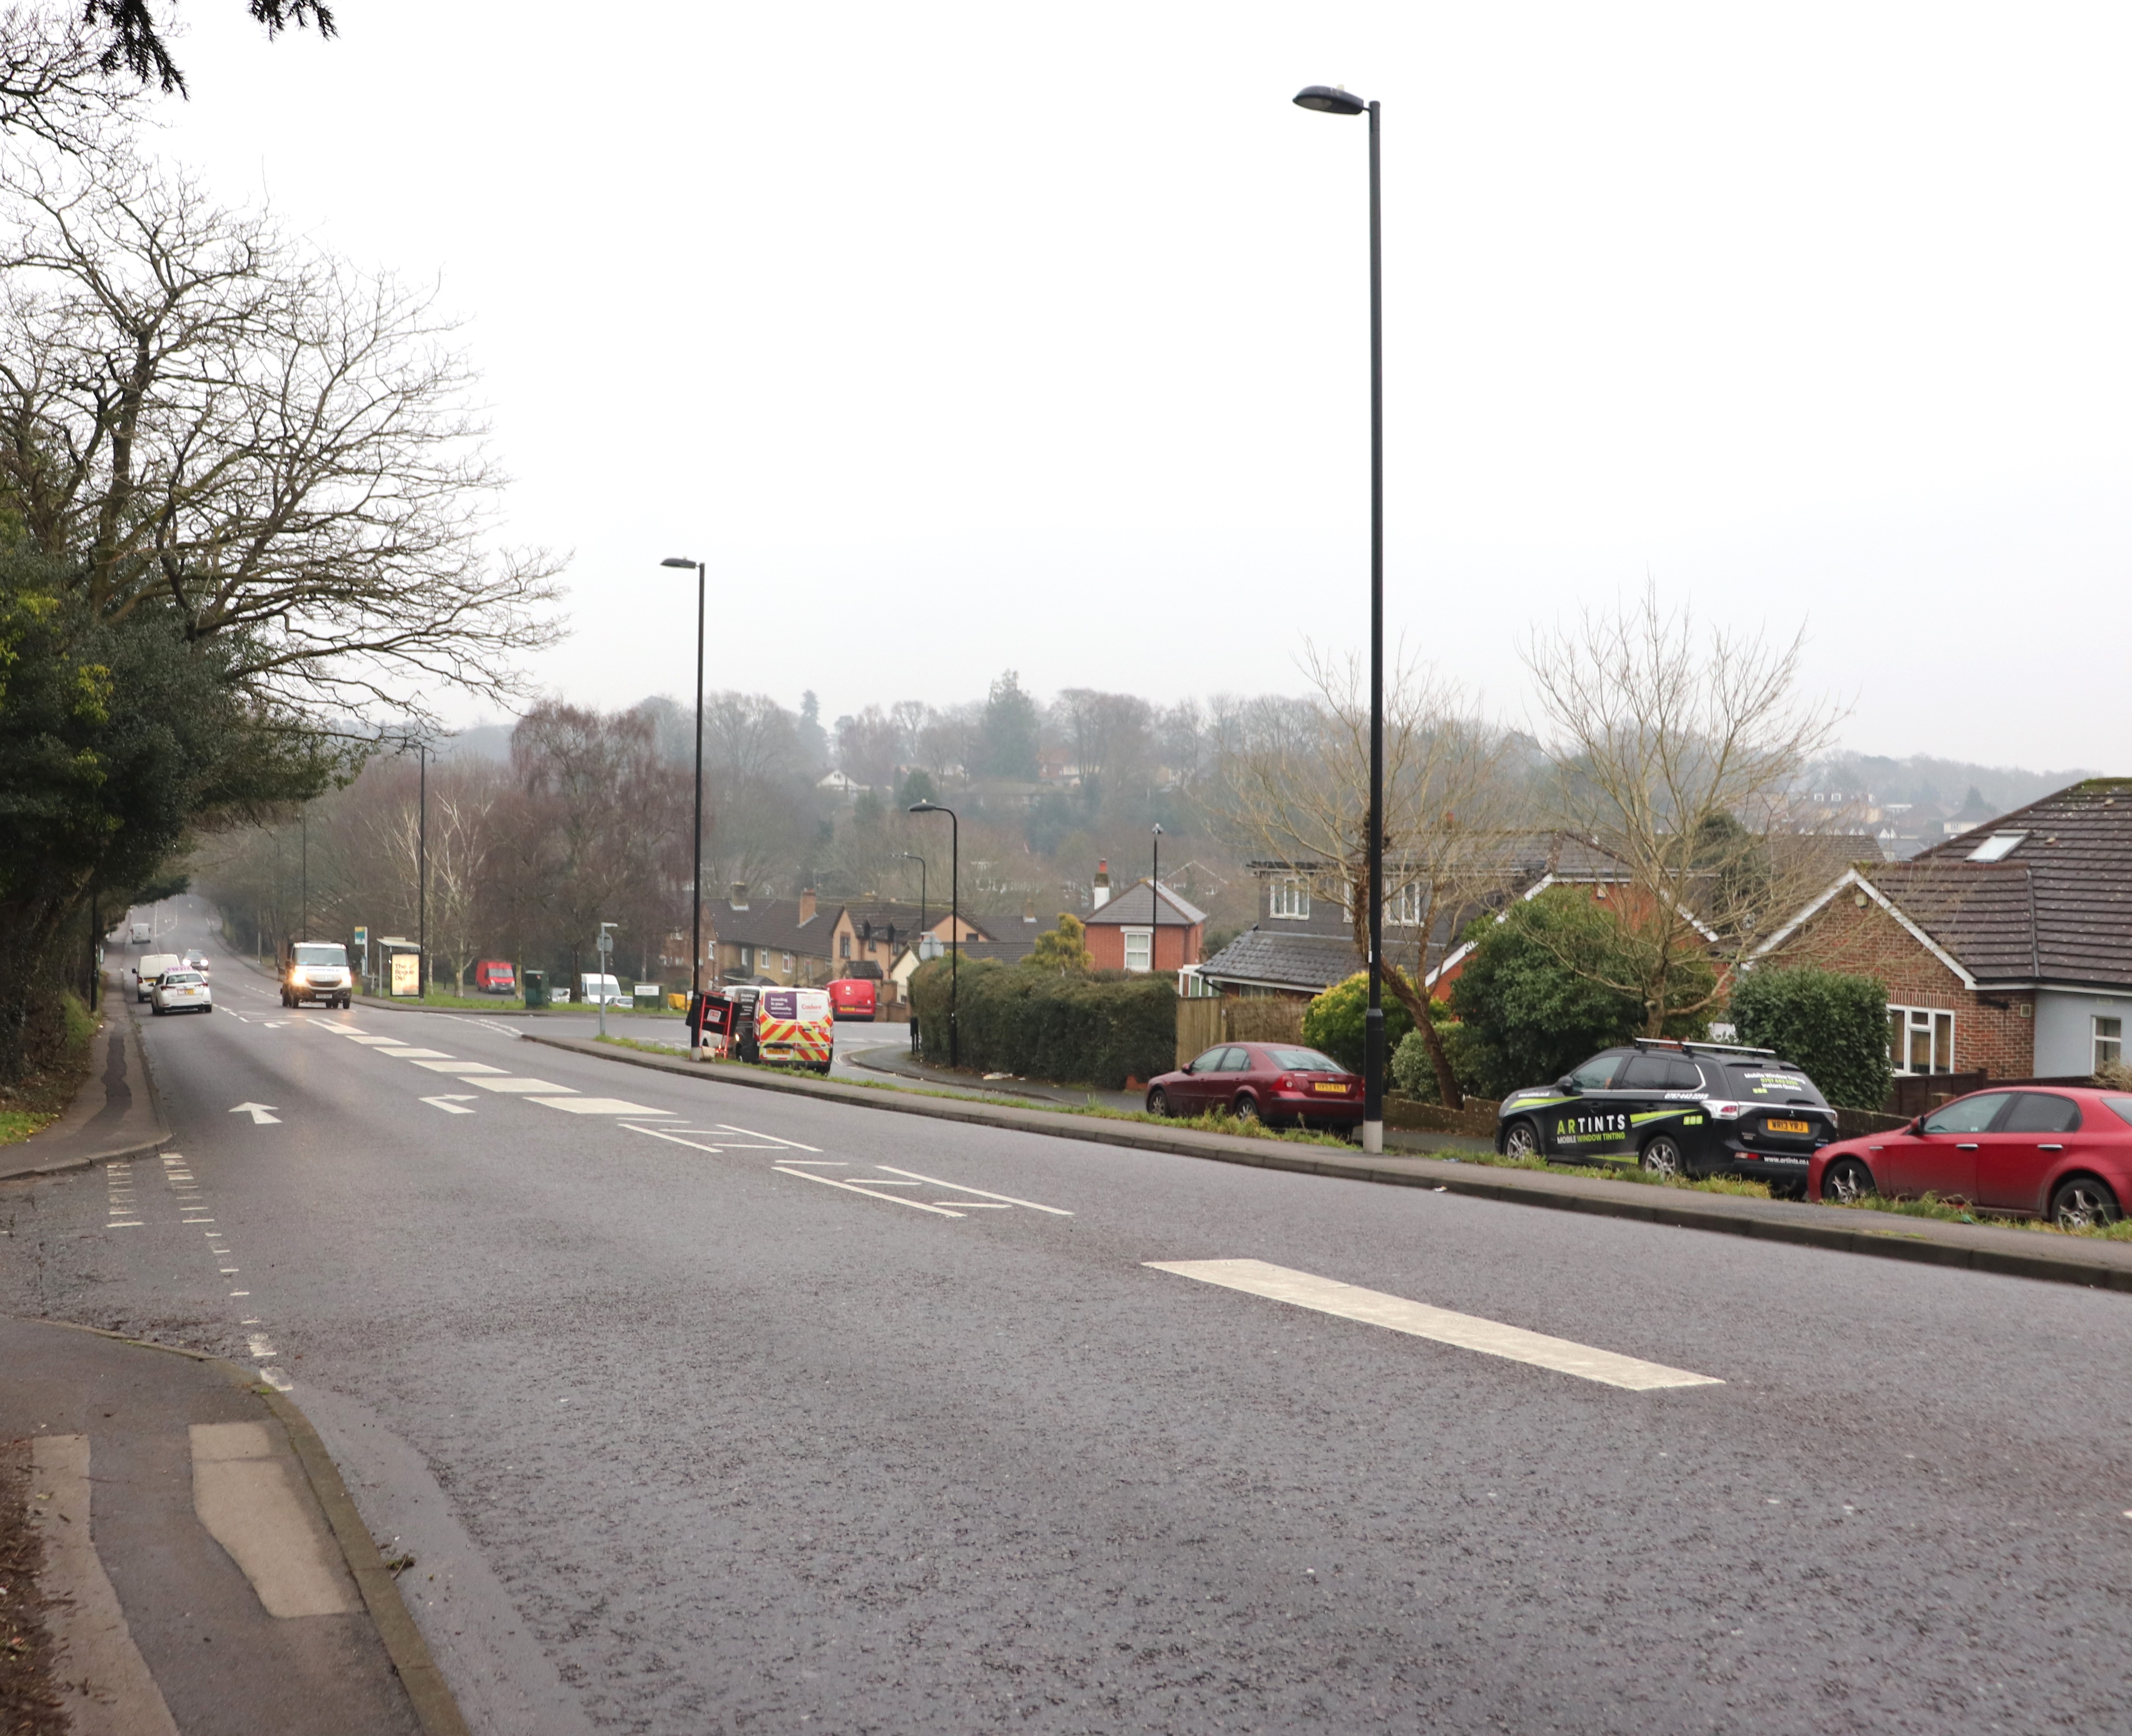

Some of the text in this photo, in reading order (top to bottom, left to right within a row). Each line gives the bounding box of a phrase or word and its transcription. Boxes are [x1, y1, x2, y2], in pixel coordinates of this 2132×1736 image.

[1557, 1114, 1625, 1135] ARTINTS
[1772, 1121, 1803, 1130] WR13 YRJ
[1557, 1131, 1625, 1144] MOBILE WINDOW TINTING
